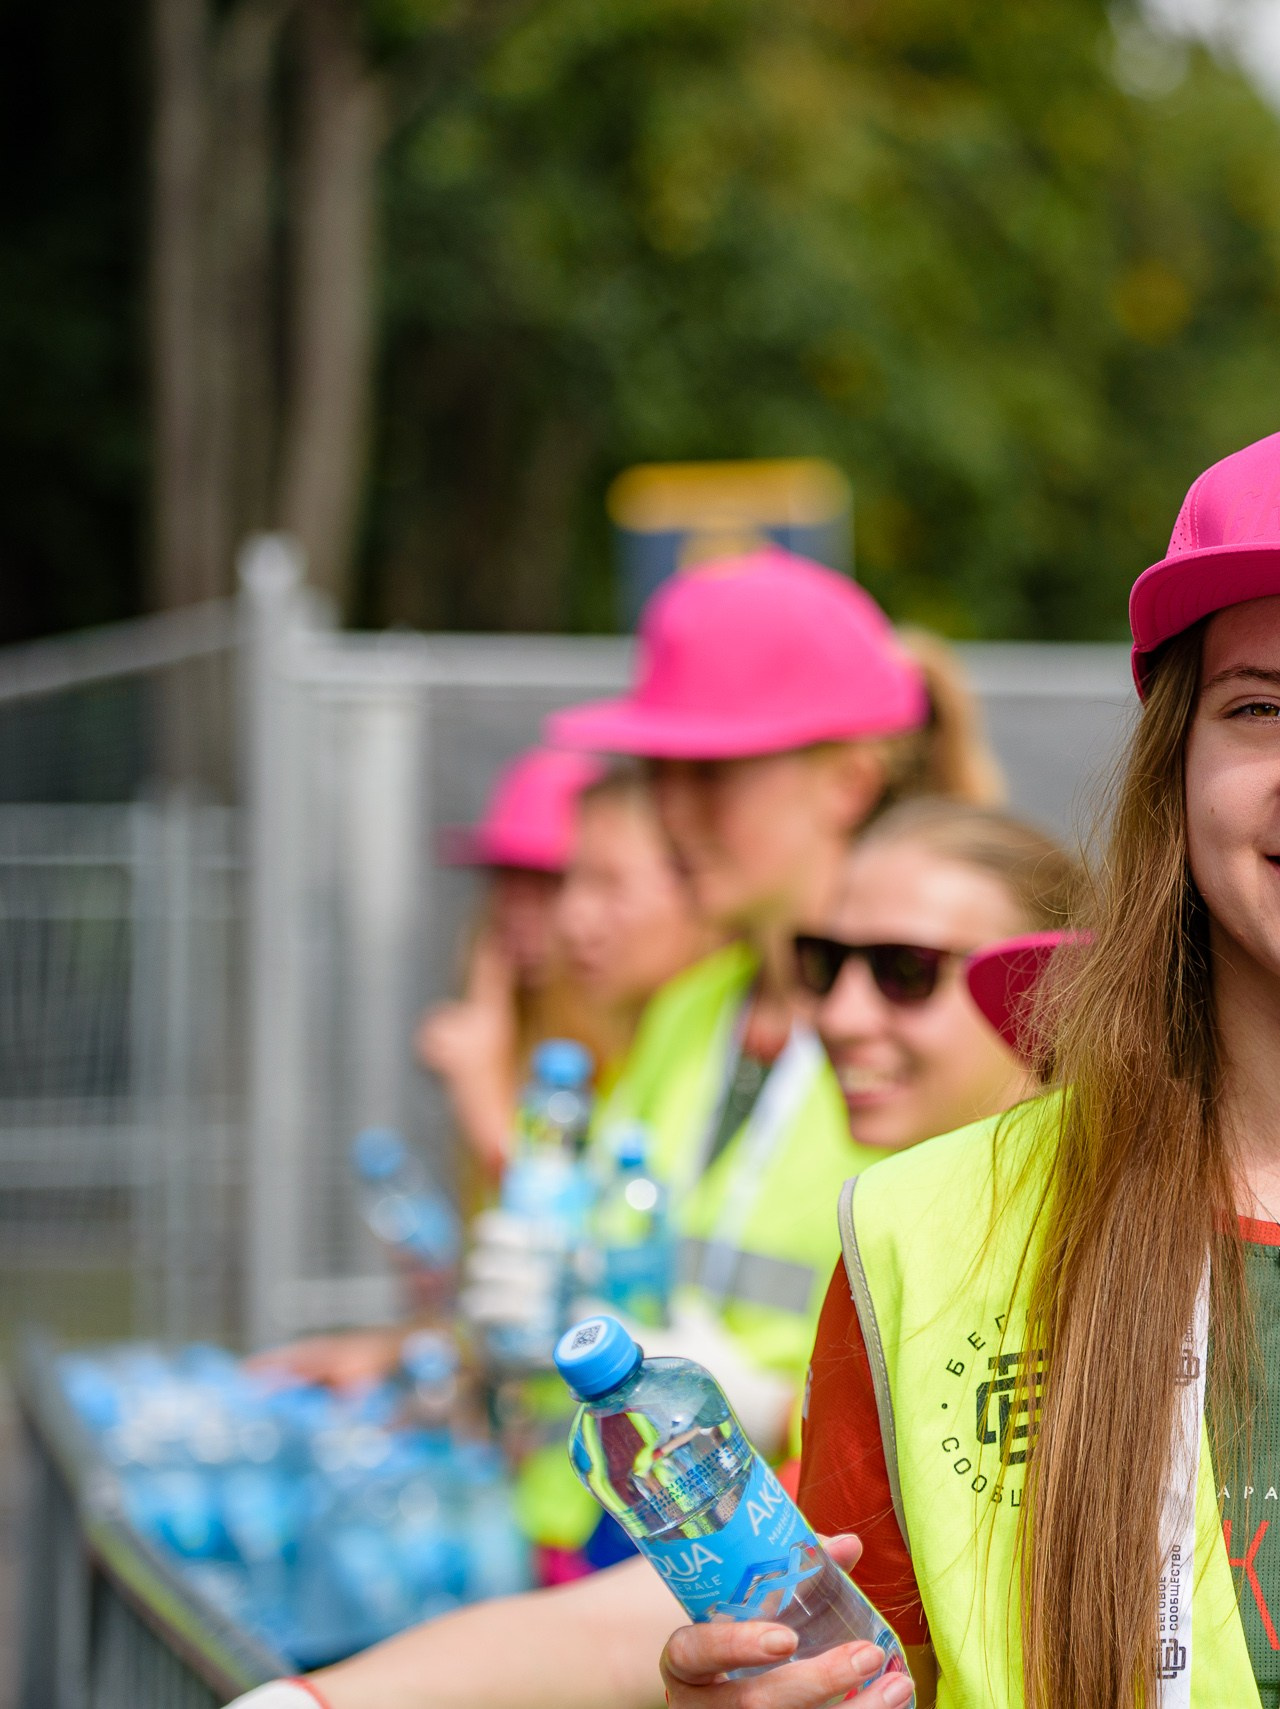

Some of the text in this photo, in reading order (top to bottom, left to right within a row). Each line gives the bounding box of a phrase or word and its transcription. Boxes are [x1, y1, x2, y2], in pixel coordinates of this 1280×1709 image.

[946, 1312, 1008, 1377] БЕГ
[646, 1541, 724, 1583] QUA
[677, 1573, 723, 1593] ERALE
[1169, 1544, 1182, 1632] СООБЩЕСТВО
